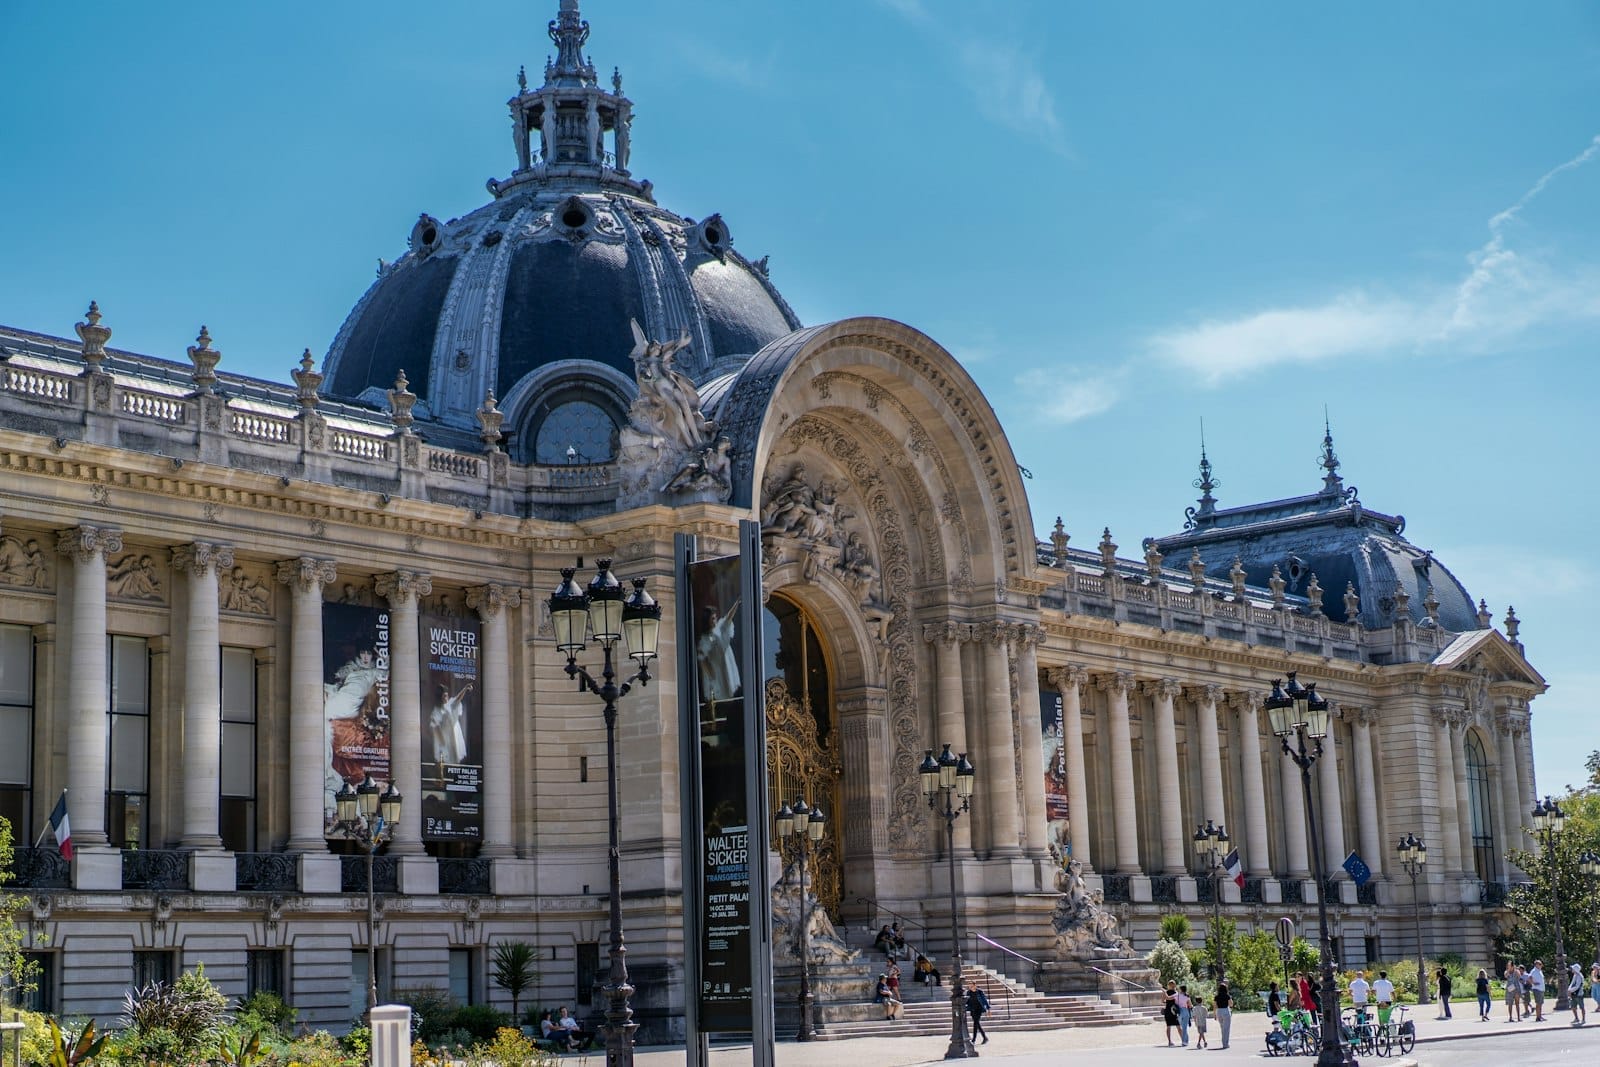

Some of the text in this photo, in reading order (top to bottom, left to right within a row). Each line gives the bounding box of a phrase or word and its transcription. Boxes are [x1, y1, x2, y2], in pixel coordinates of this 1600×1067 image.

[430, 627, 476, 645] WALTER
[430, 641, 478, 659] SICKERT
[375, 614, 389, 720] Petit Palais
[1054, 696, 1066, 774] Petit Palais
[707, 849, 749, 866] SICKER
[706, 872, 750, 882] TRANSGRESSE
[708, 892, 749, 904] PETIT PALAI
